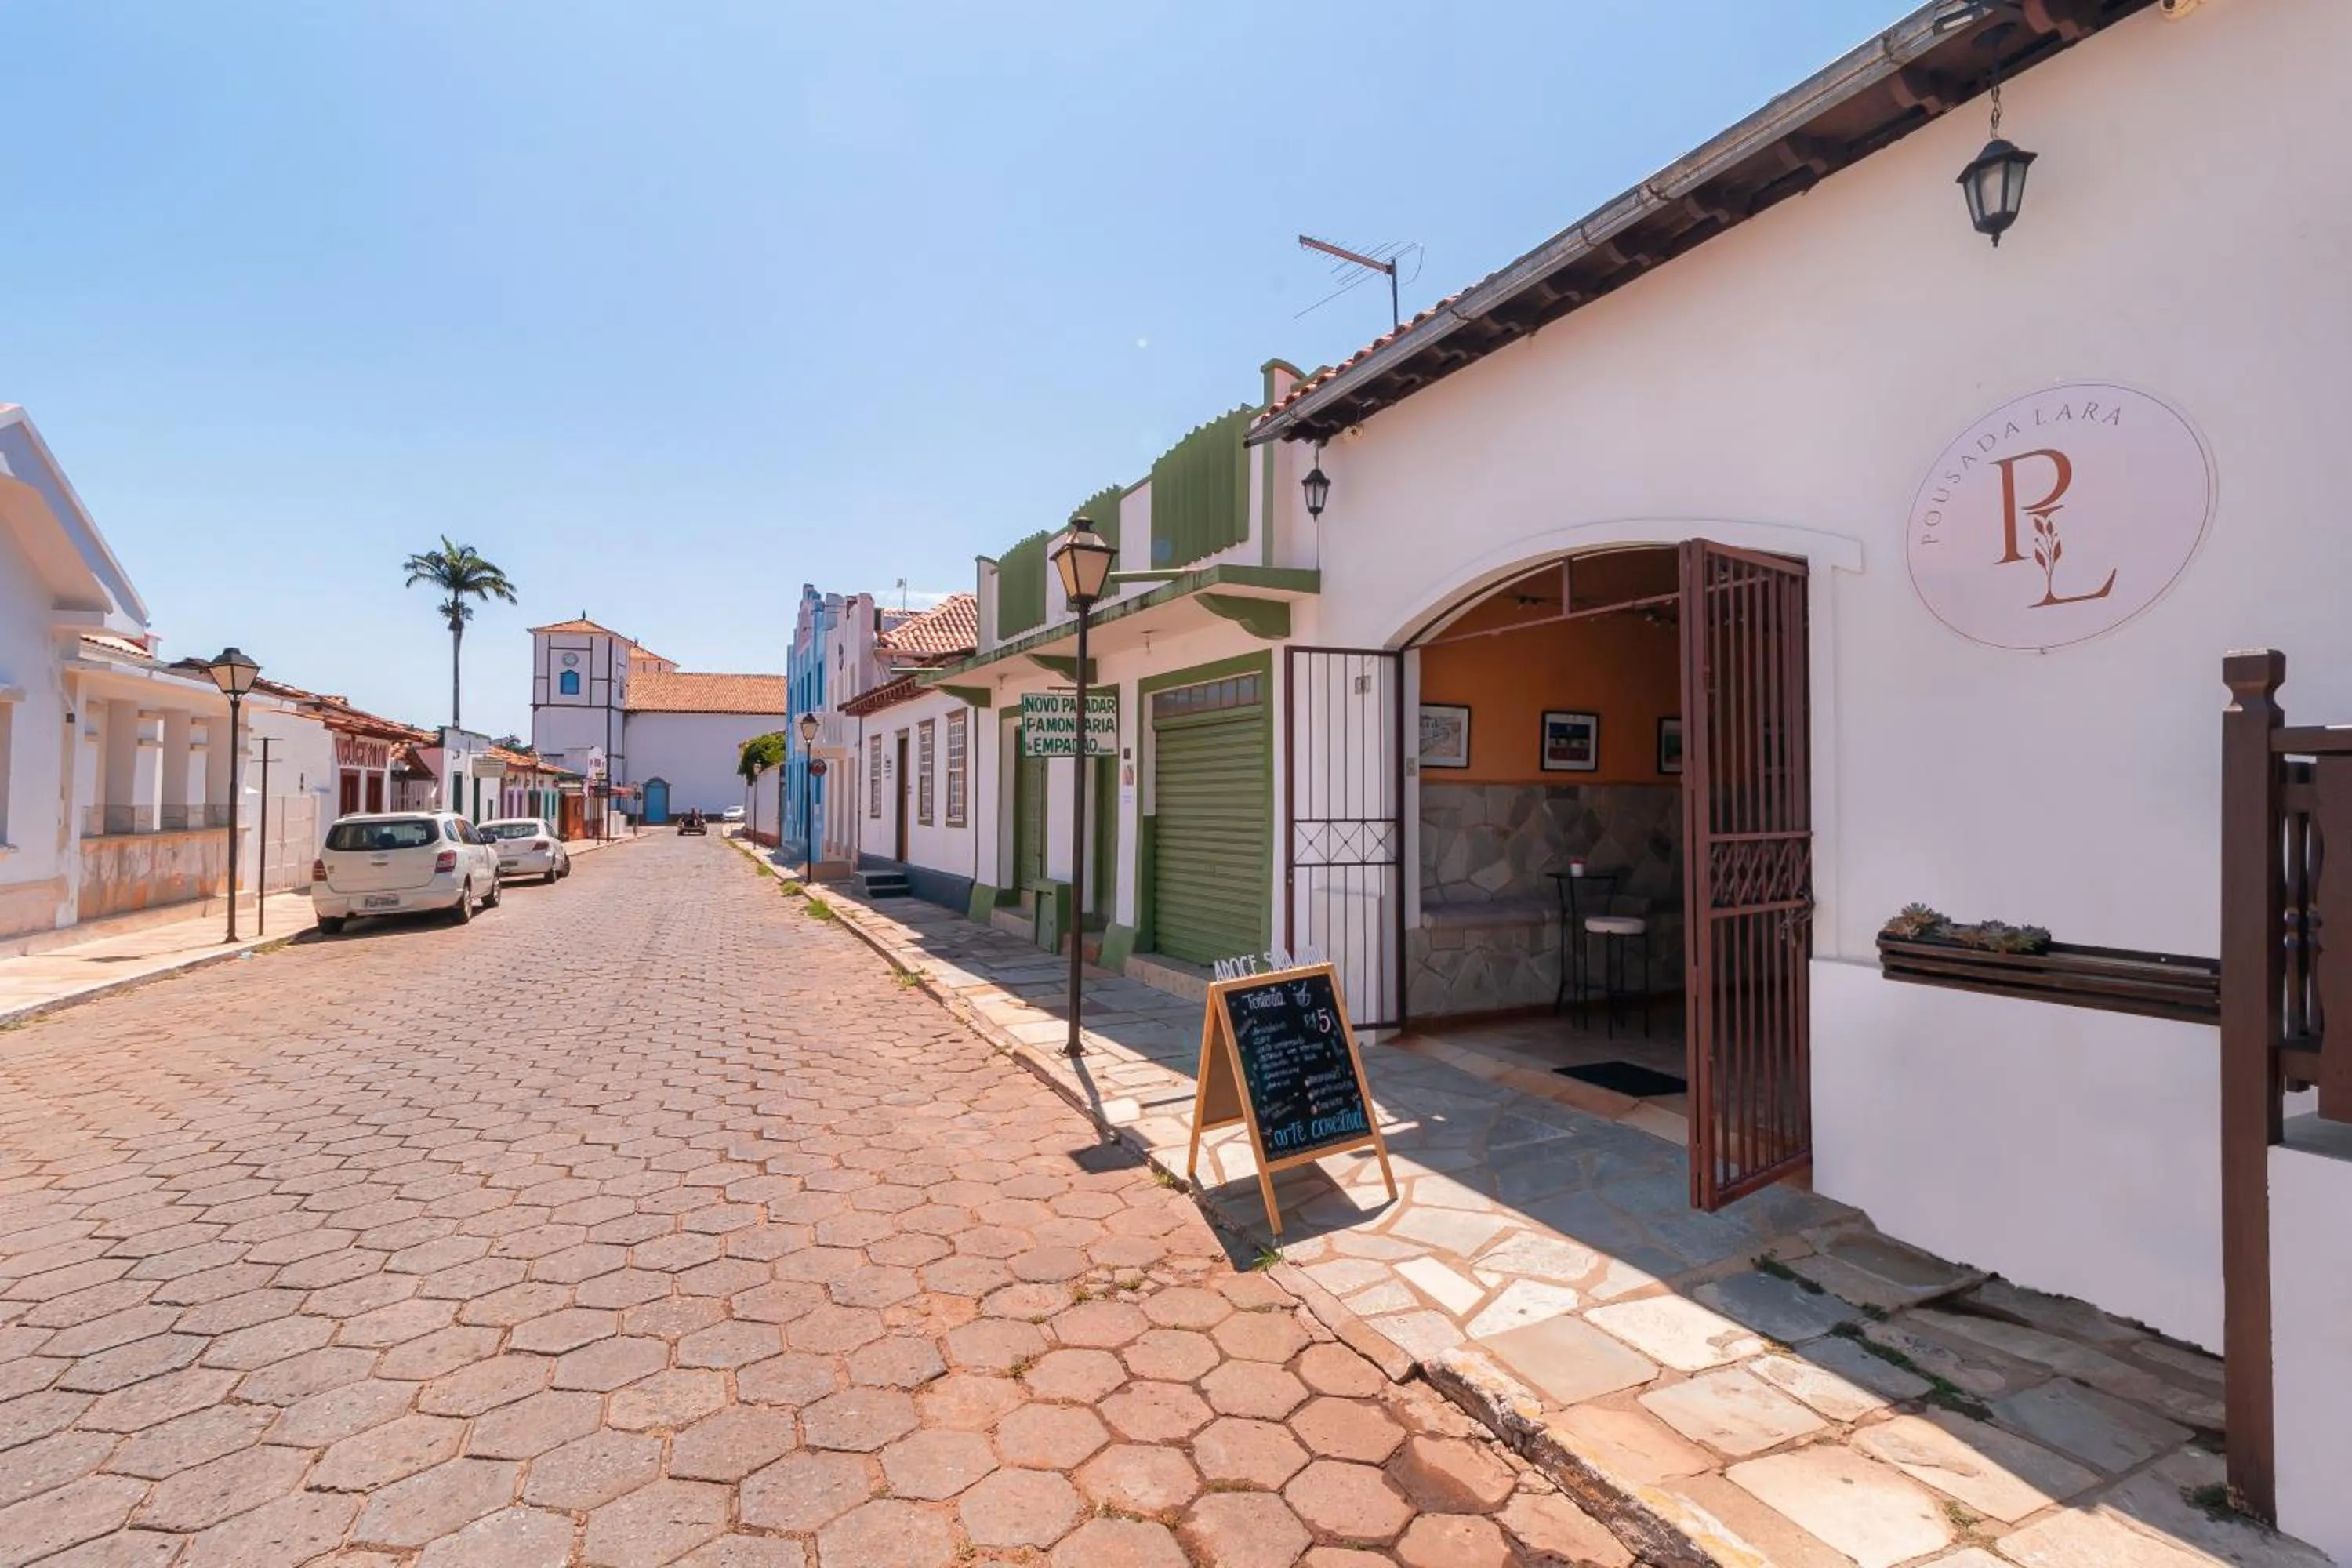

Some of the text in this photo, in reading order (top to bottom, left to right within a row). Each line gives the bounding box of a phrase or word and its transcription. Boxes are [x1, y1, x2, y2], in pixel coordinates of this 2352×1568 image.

[1921, 401, 2122, 546] POUSADA LARA
[1025, 696, 1116, 714] NOVO PAADAR
[1026, 717, 1116, 734] PAMONARIA
